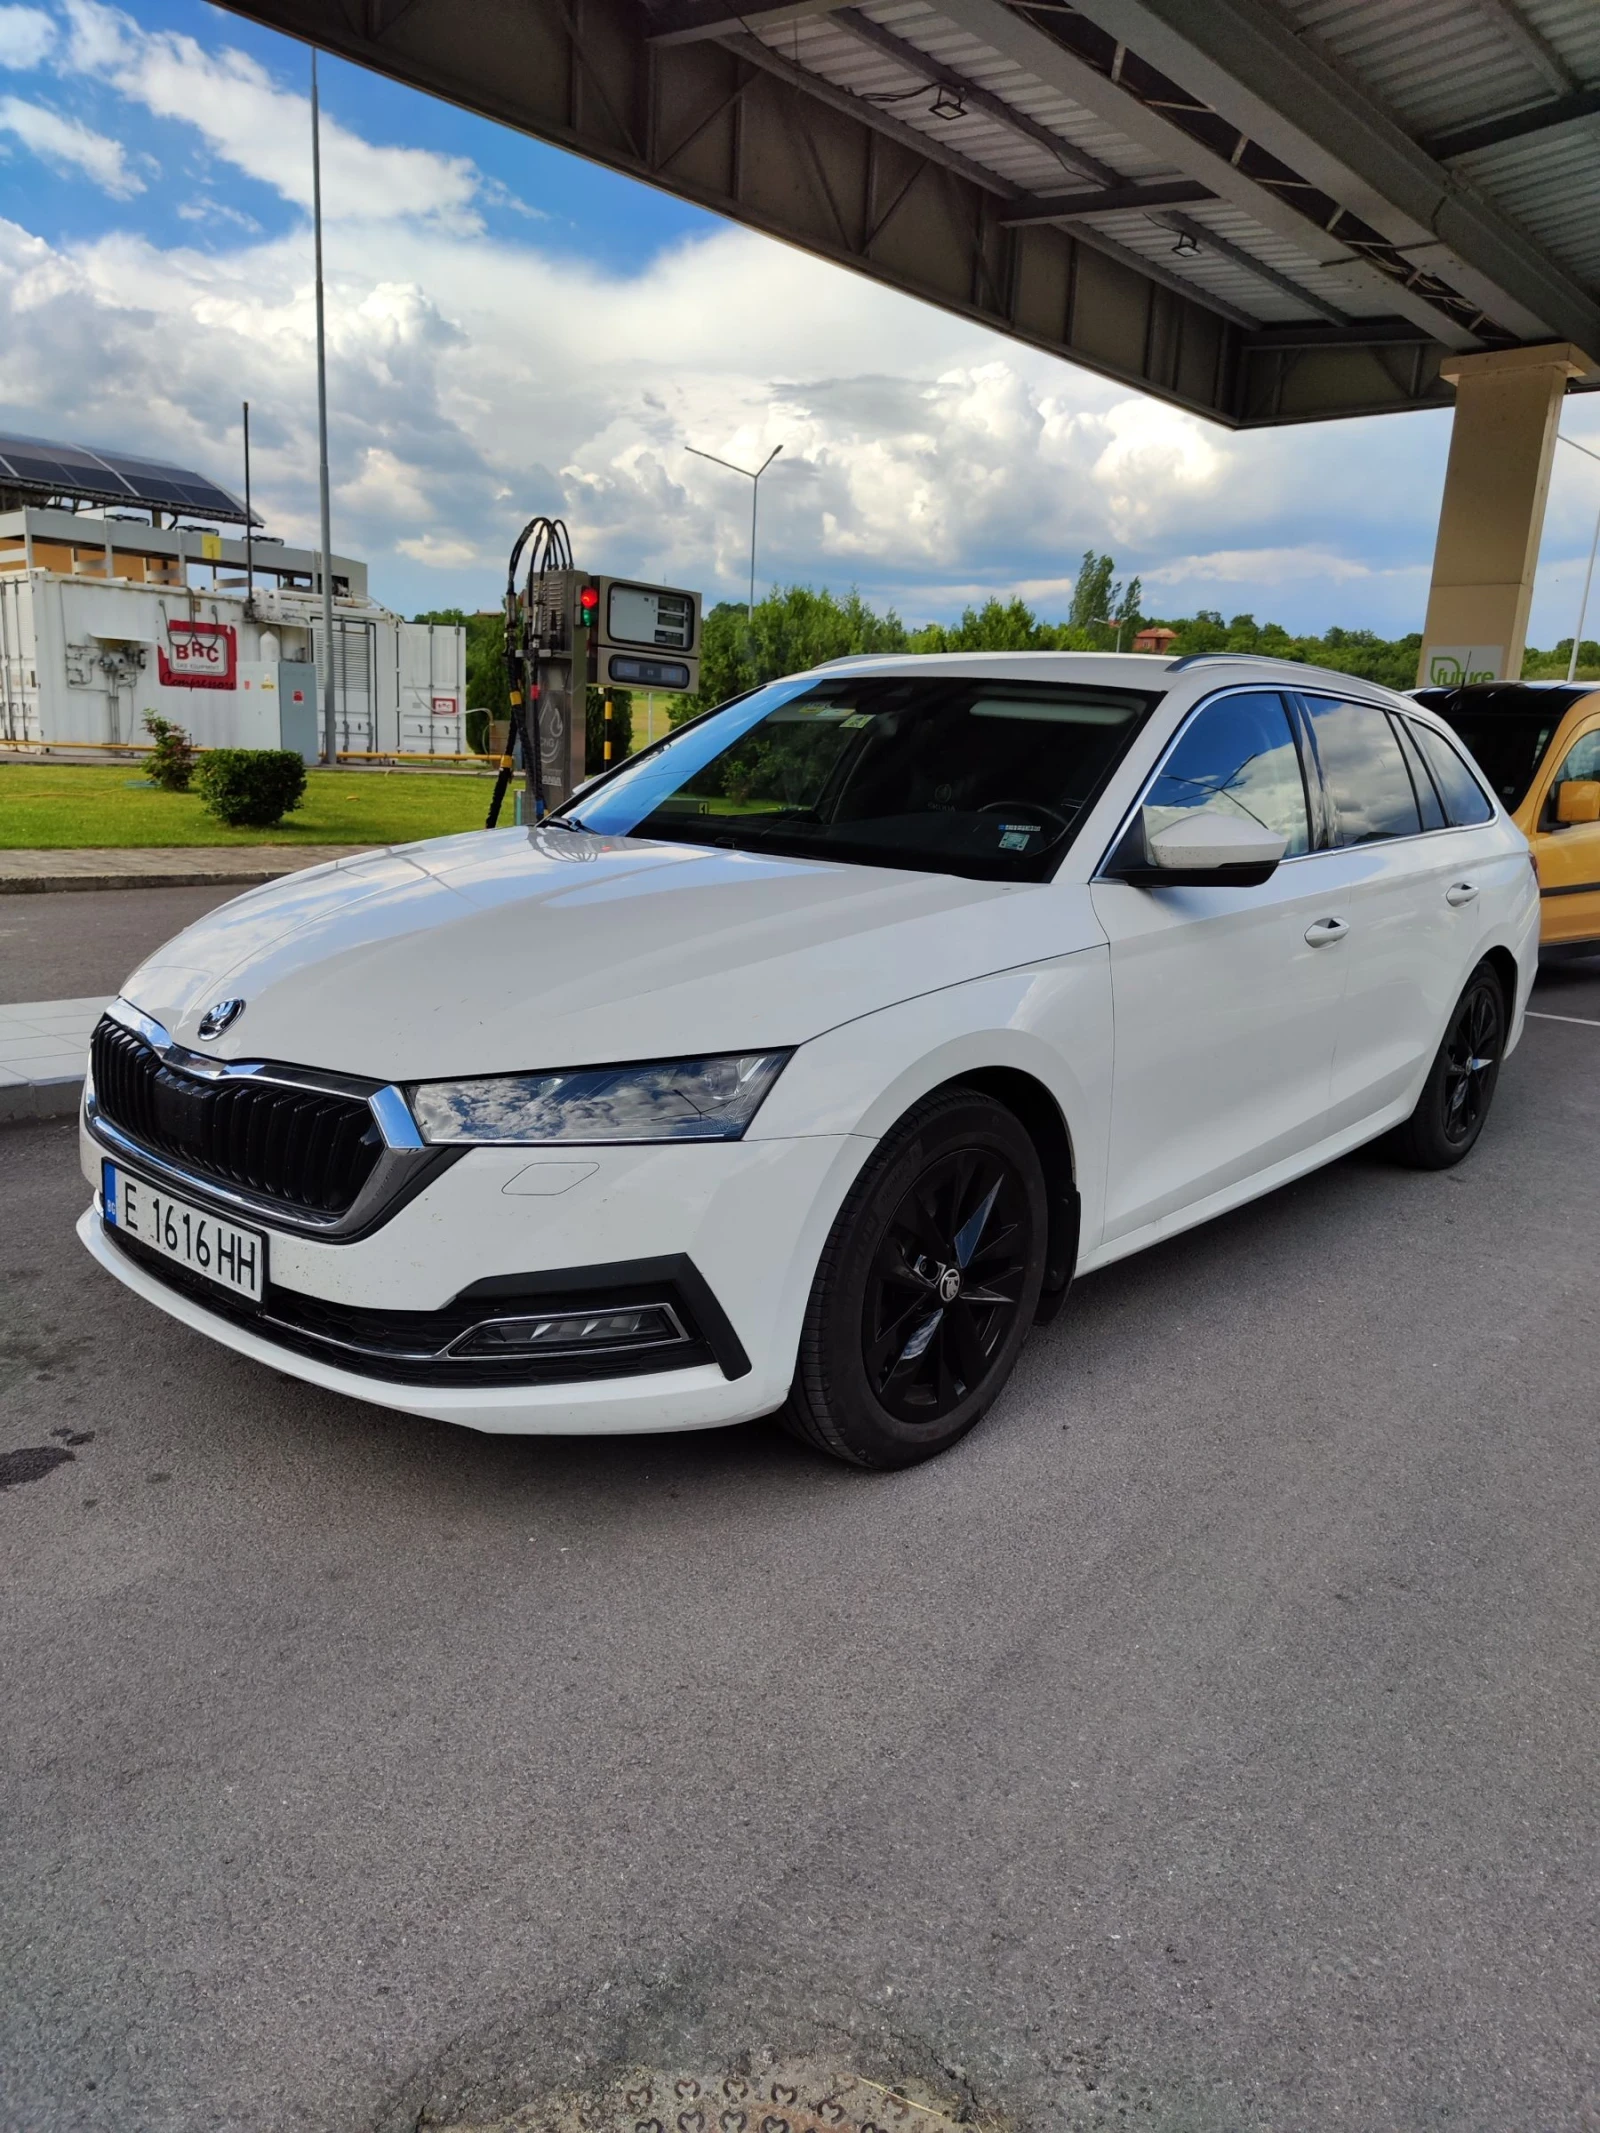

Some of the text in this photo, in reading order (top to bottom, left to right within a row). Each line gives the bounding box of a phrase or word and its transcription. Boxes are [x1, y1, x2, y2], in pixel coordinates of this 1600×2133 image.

[176, 641, 219, 663] BRC
[162, 672, 234, 690] Compressors
[107, 1182, 255, 1291] BG E 1616 HH
